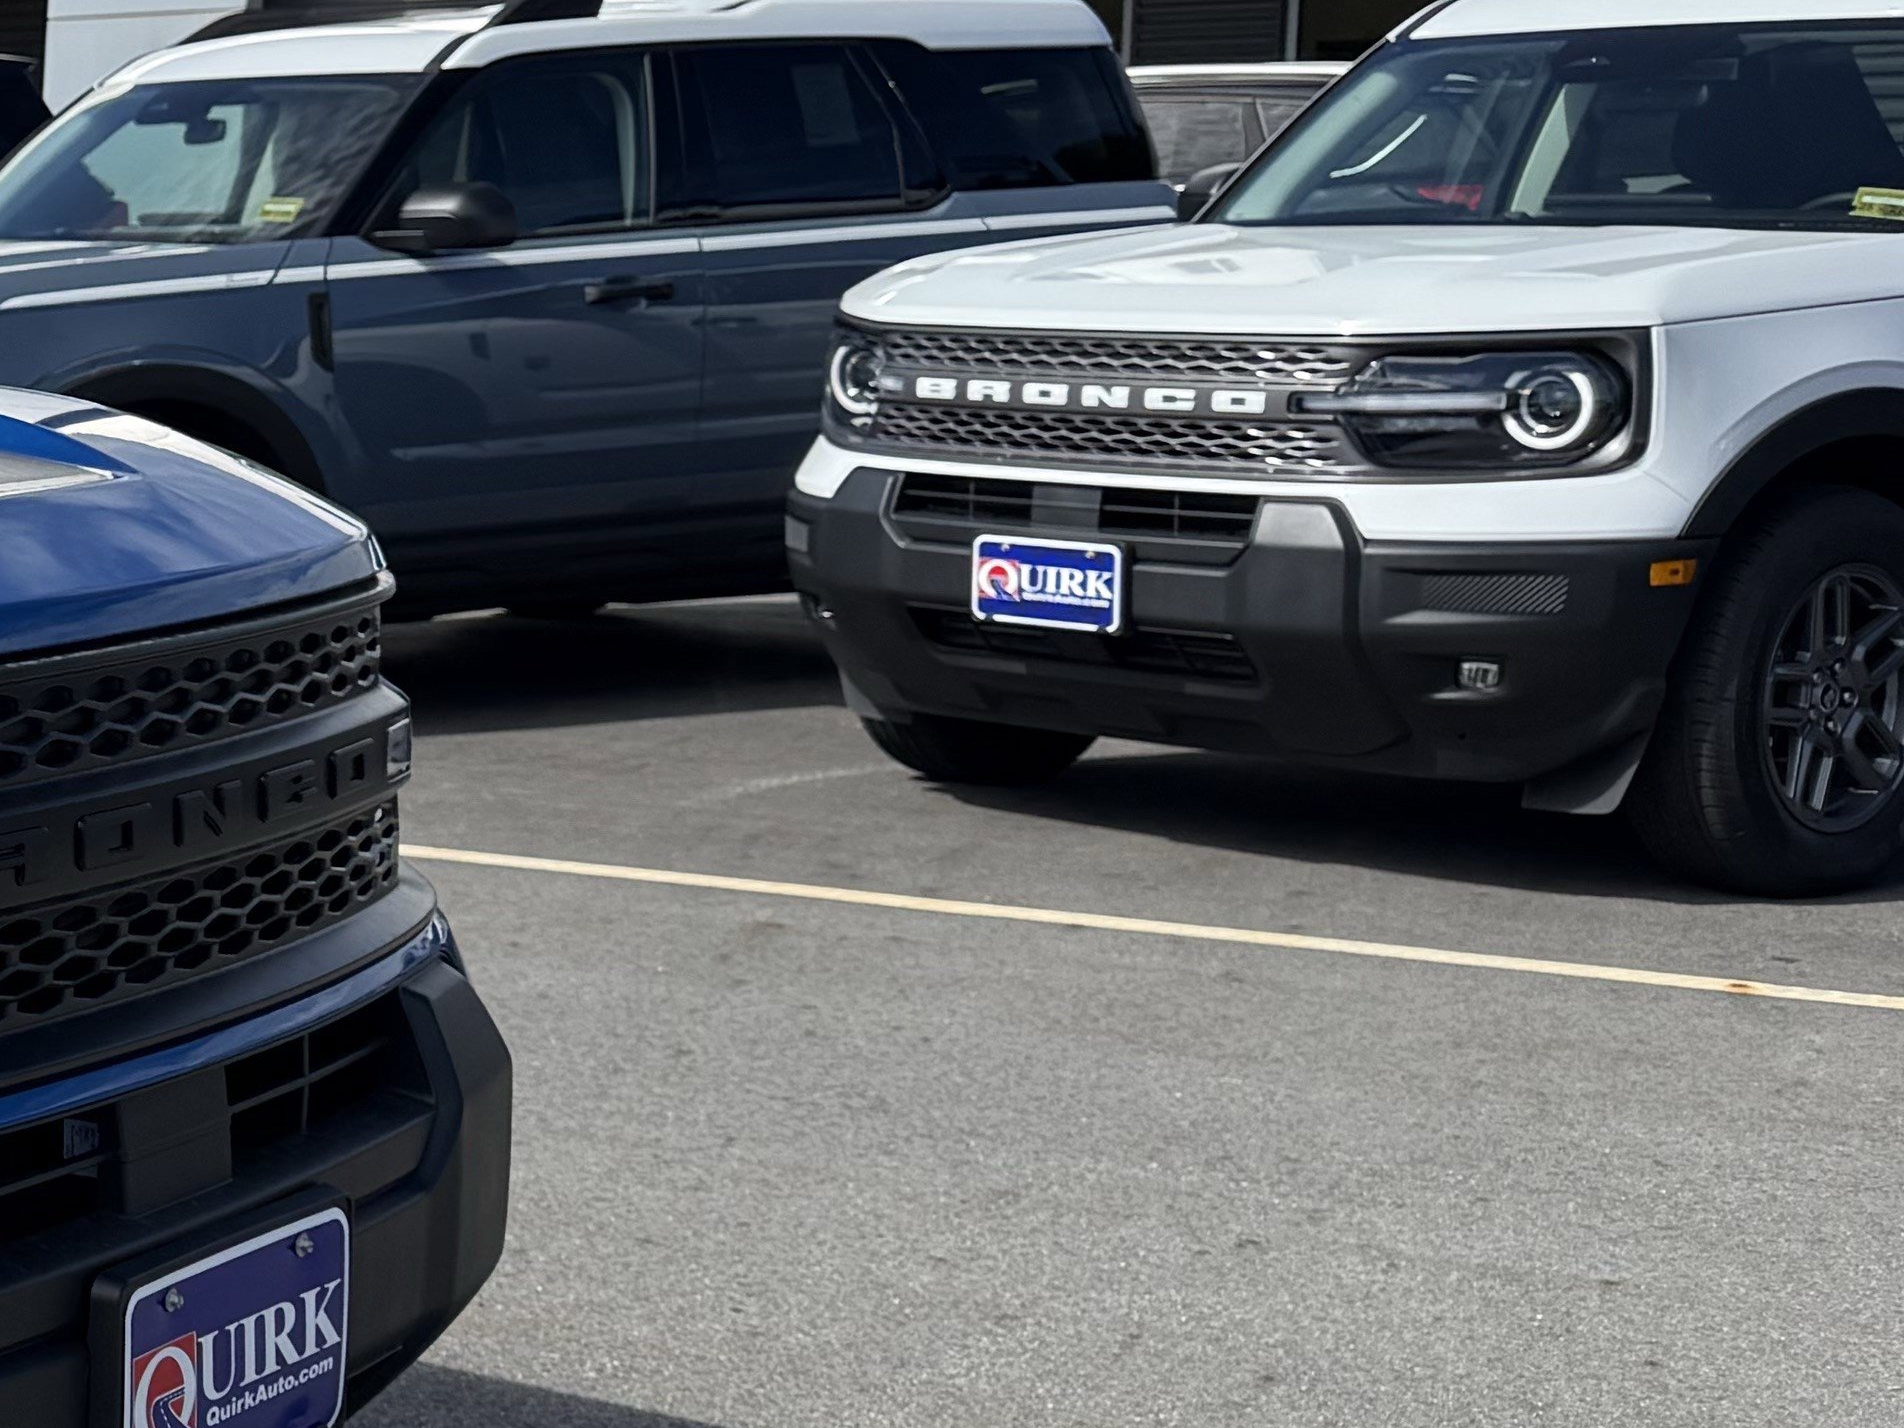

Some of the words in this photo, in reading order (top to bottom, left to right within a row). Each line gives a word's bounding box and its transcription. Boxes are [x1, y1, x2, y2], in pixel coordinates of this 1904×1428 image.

[915, 376, 1266, 415] BRONCO
[979, 558, 1113, 603] QUIRK
[206, 1356, 334, 1427] QuirkAuto.com
